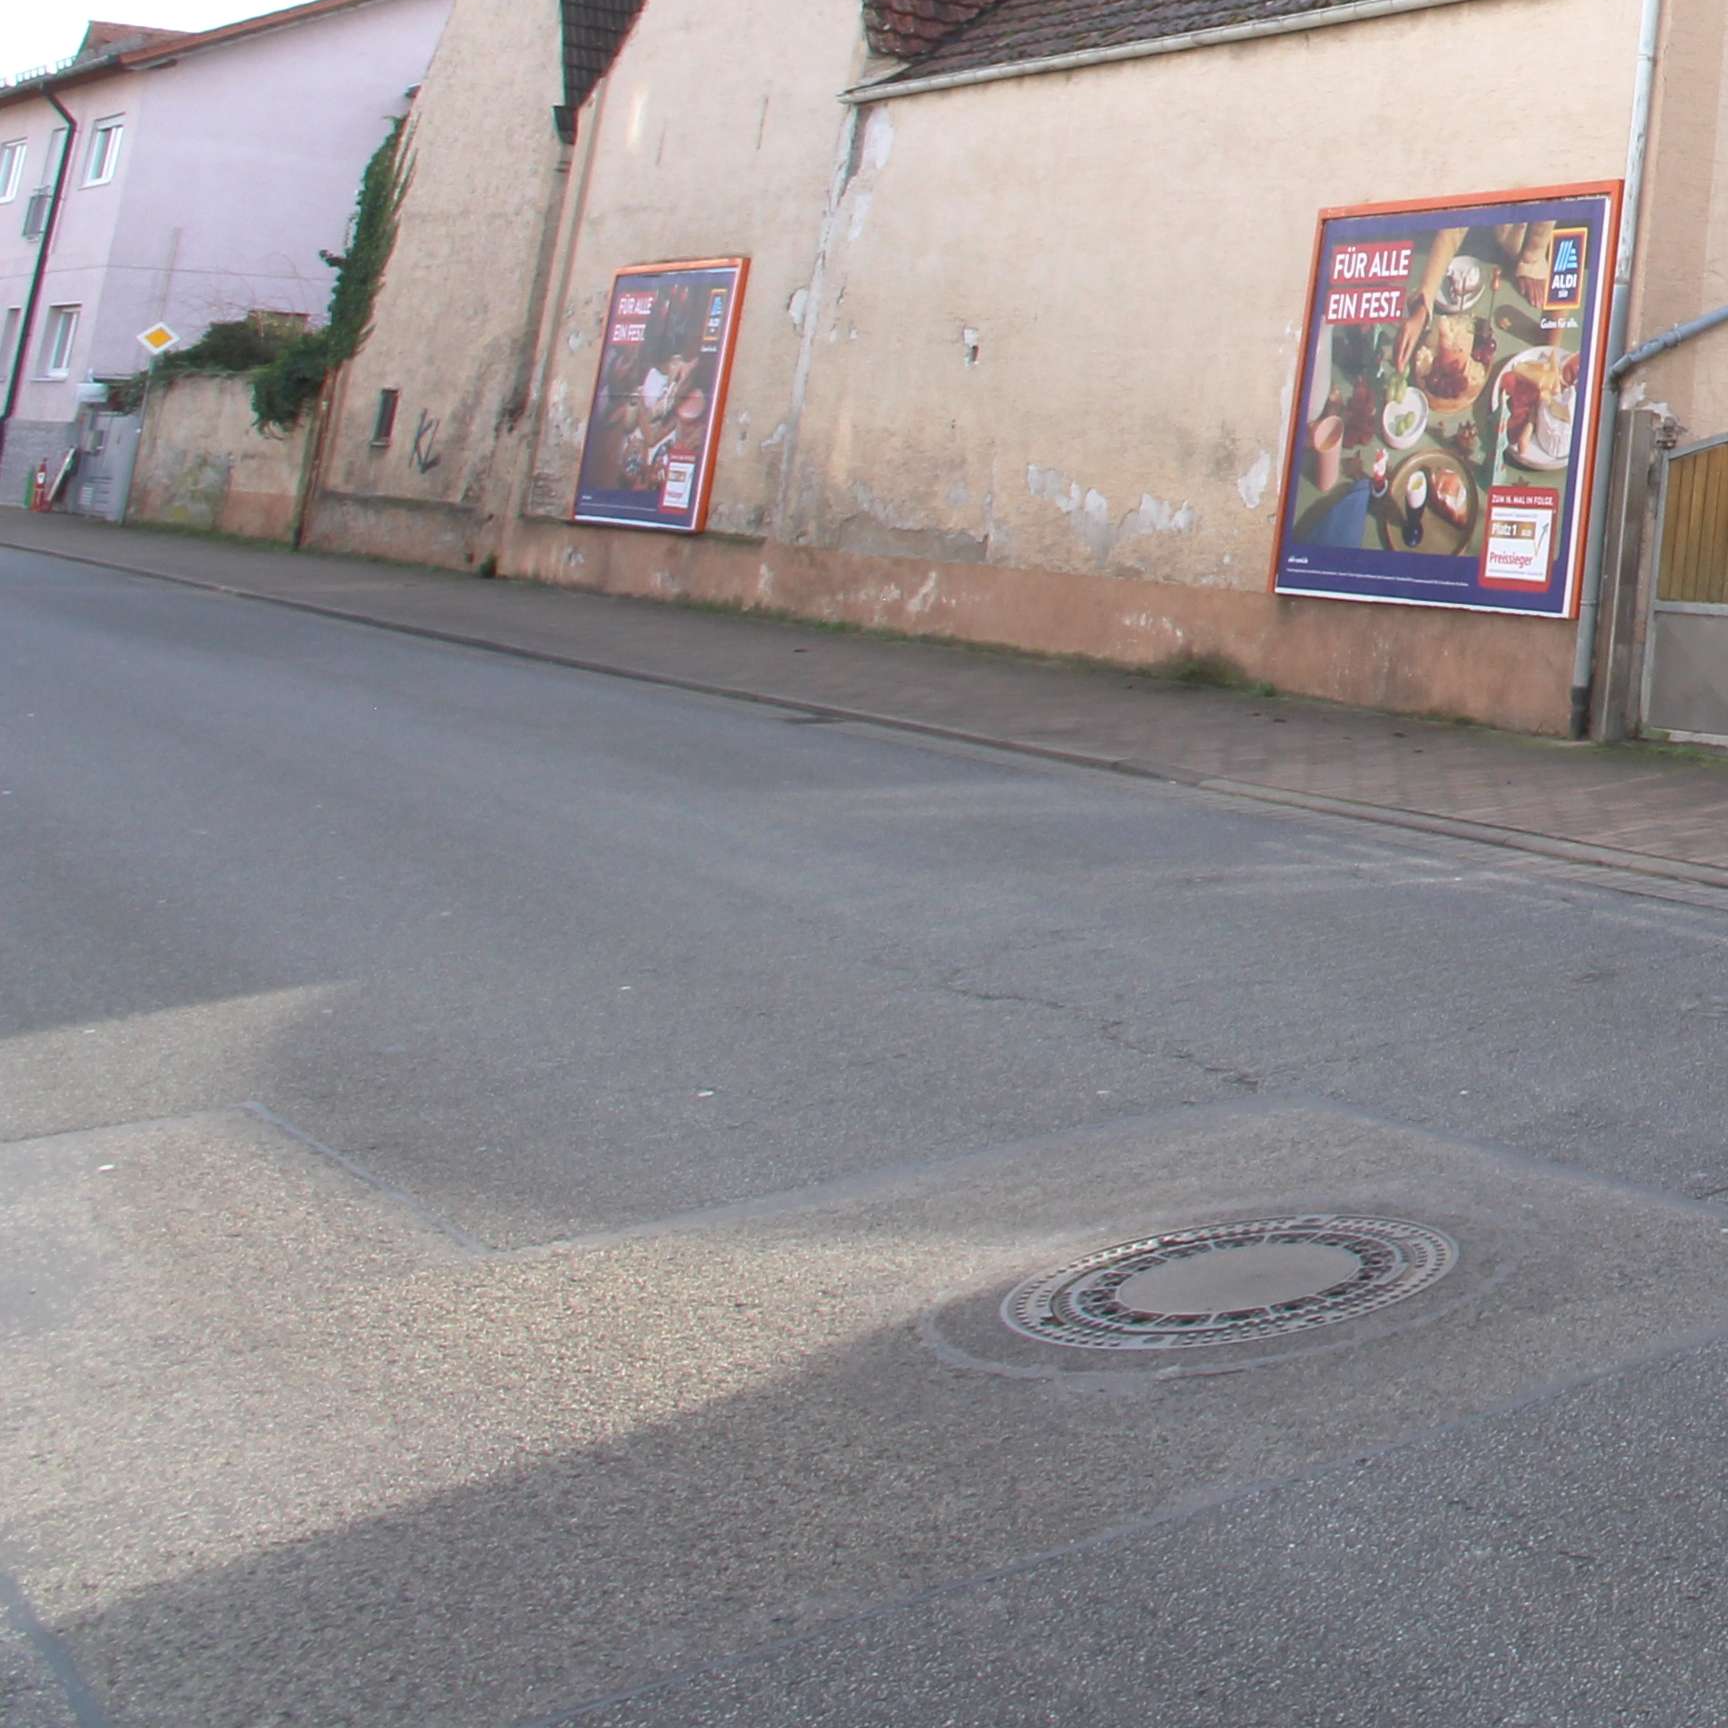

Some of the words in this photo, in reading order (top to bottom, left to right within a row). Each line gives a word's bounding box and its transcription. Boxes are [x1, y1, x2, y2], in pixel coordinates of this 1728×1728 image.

[1333, 246, 1368, 280] FÜR
[1368, 249, 1411, 278] ALLE
[1551, 273, 1578, 290] ALDI
[1327, 293, 1358, 320] EIN
[1360, 290, 1401, 319] FEST.
